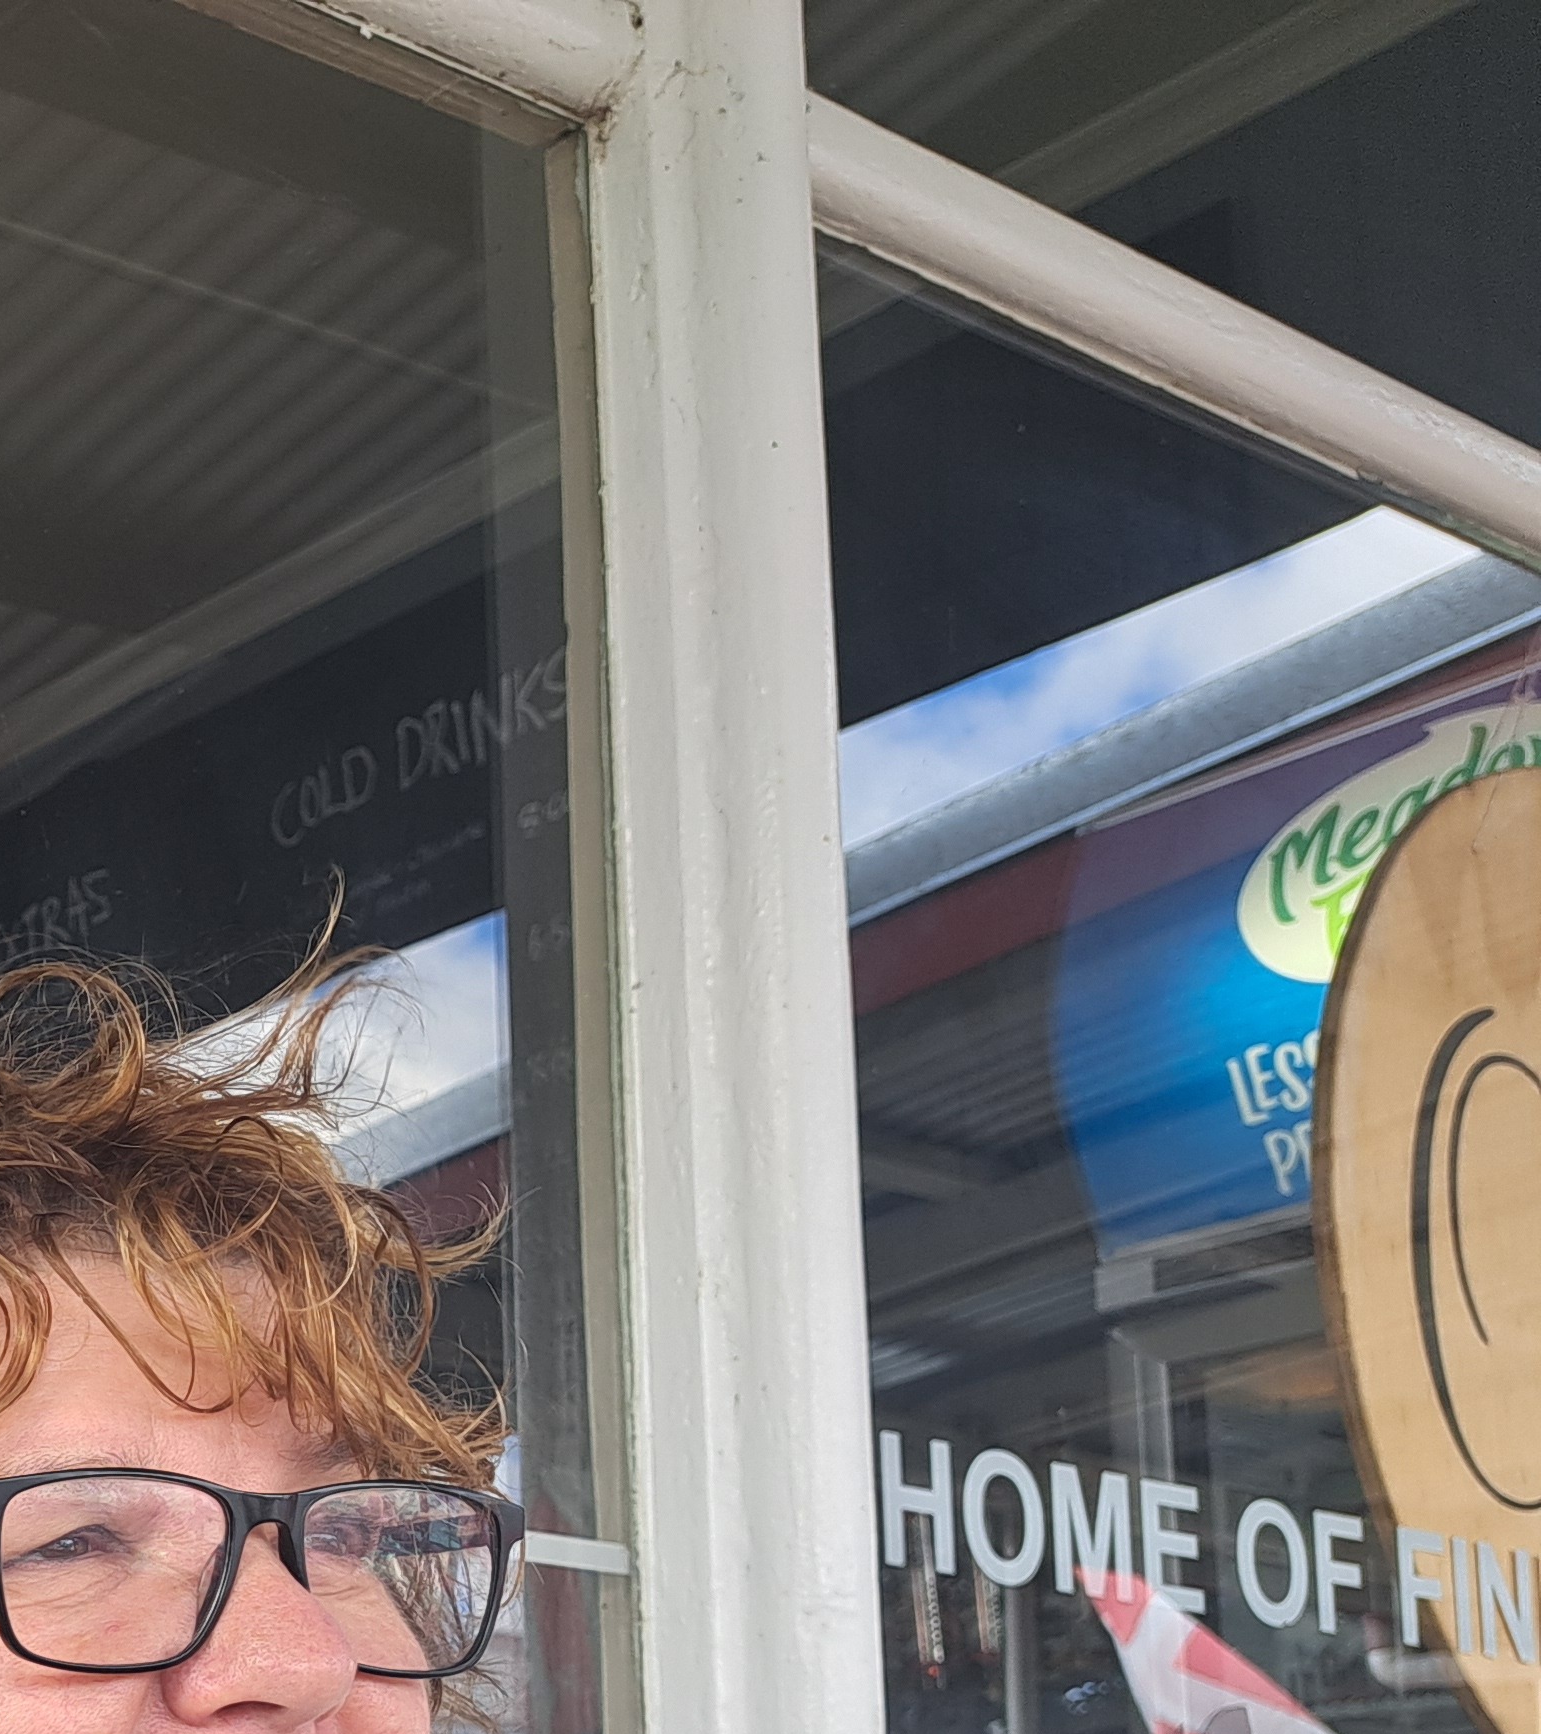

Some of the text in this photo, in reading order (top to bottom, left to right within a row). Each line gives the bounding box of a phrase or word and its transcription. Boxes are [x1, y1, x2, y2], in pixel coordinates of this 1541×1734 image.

[269, 744, 376, 848] COLD
[878, 1429, 1207, 1616] HOME
[1235, 1498, 1365, 1636] OF
